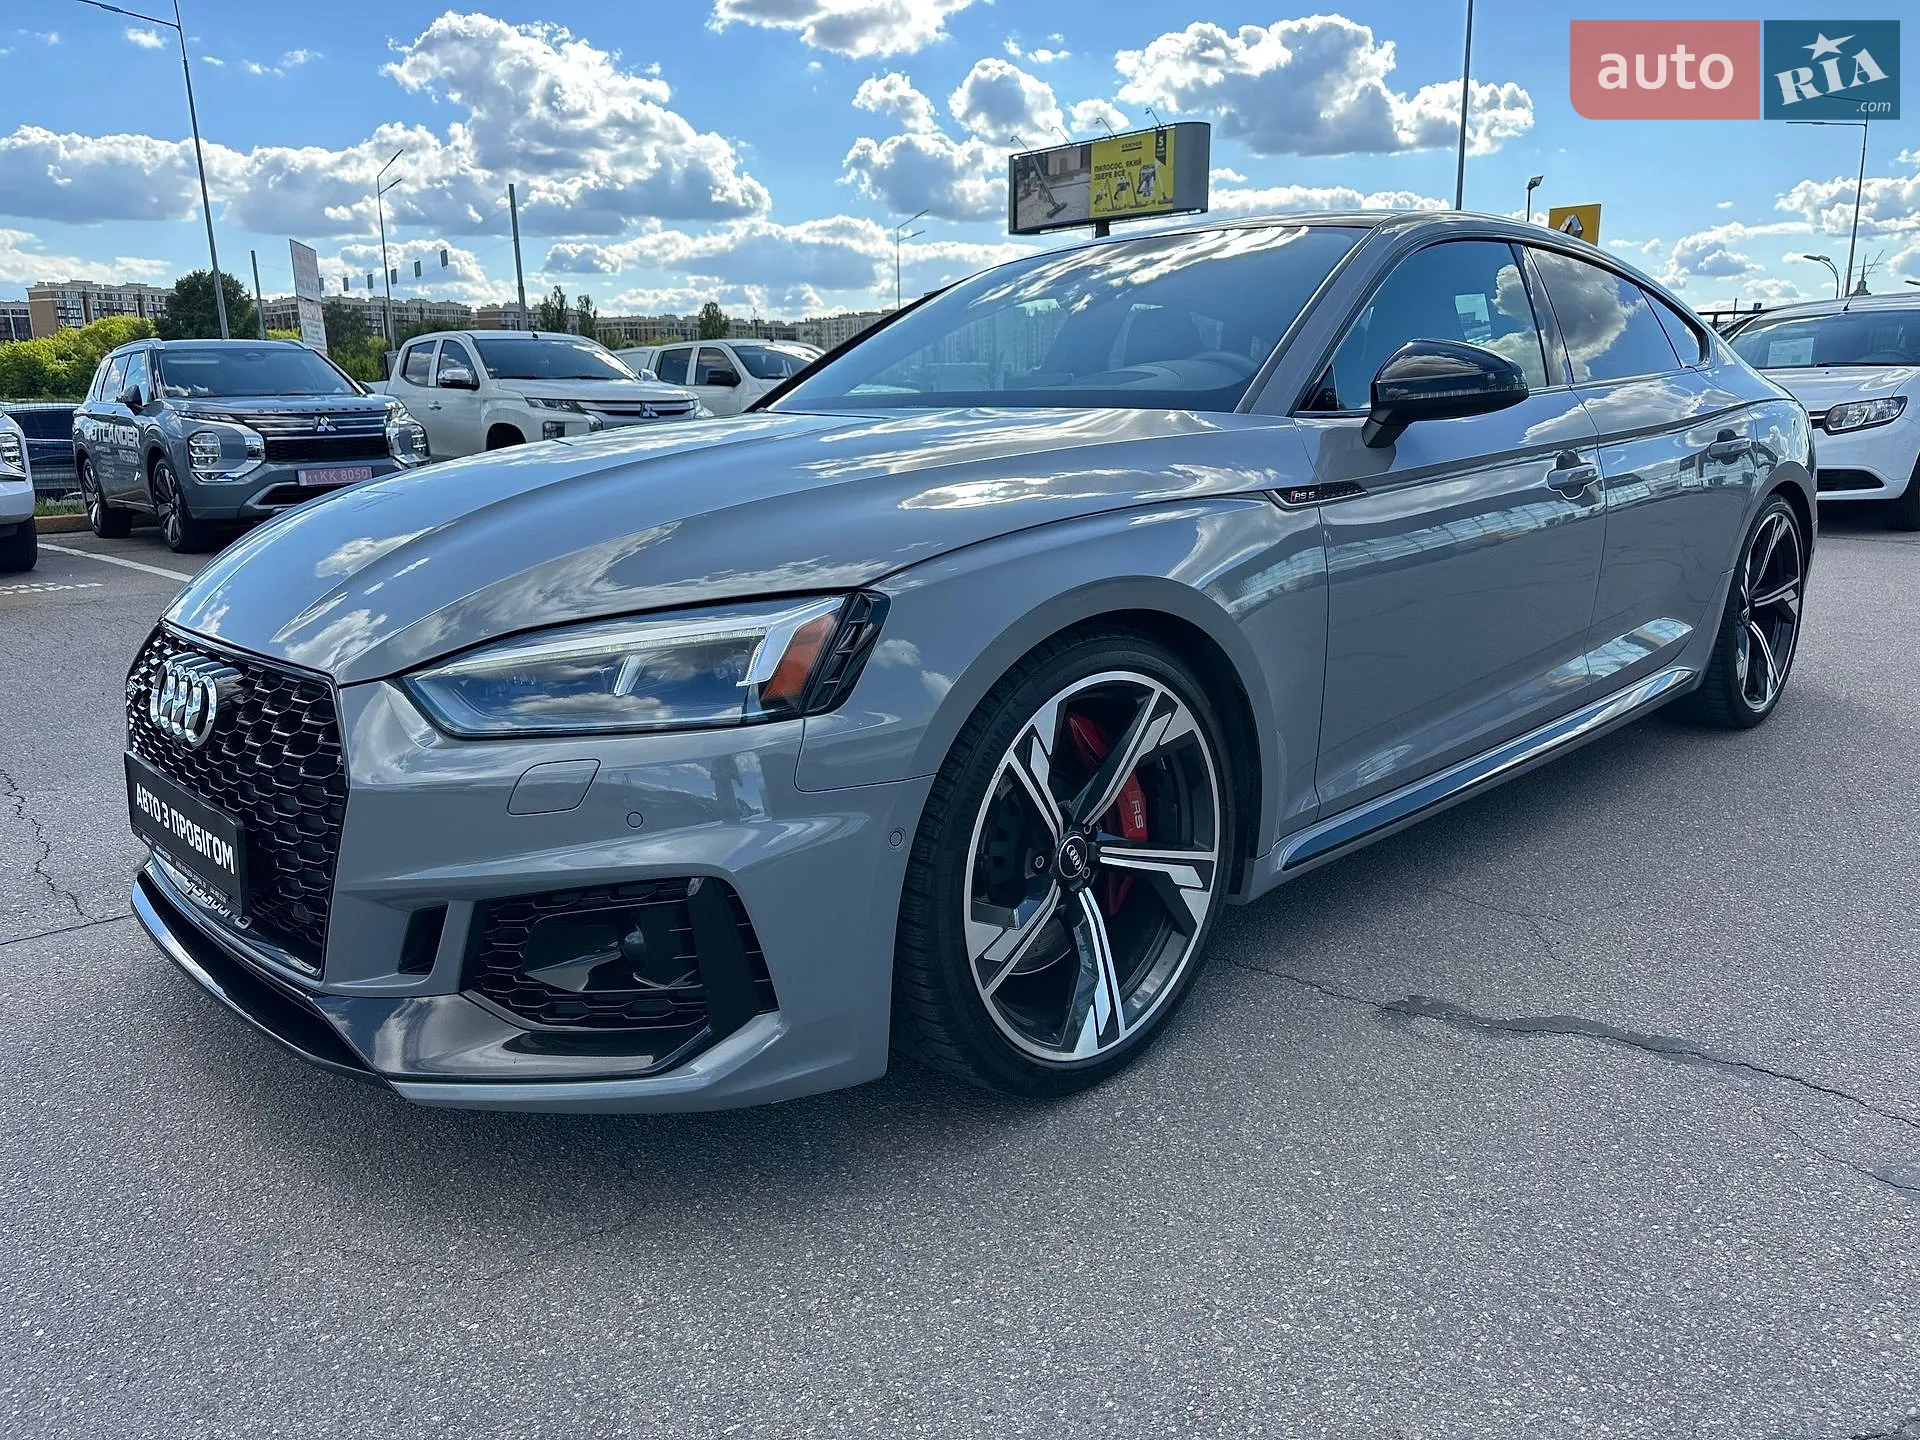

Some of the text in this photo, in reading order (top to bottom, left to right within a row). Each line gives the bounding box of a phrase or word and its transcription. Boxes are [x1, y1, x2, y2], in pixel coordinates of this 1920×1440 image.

[340, 468, 368, 481] 8050
[135, 782, 161, 823] АВТО
[170, 806, 236, 875] ПРОБІГОМ
[1131, 799, 1144, 829] RS
